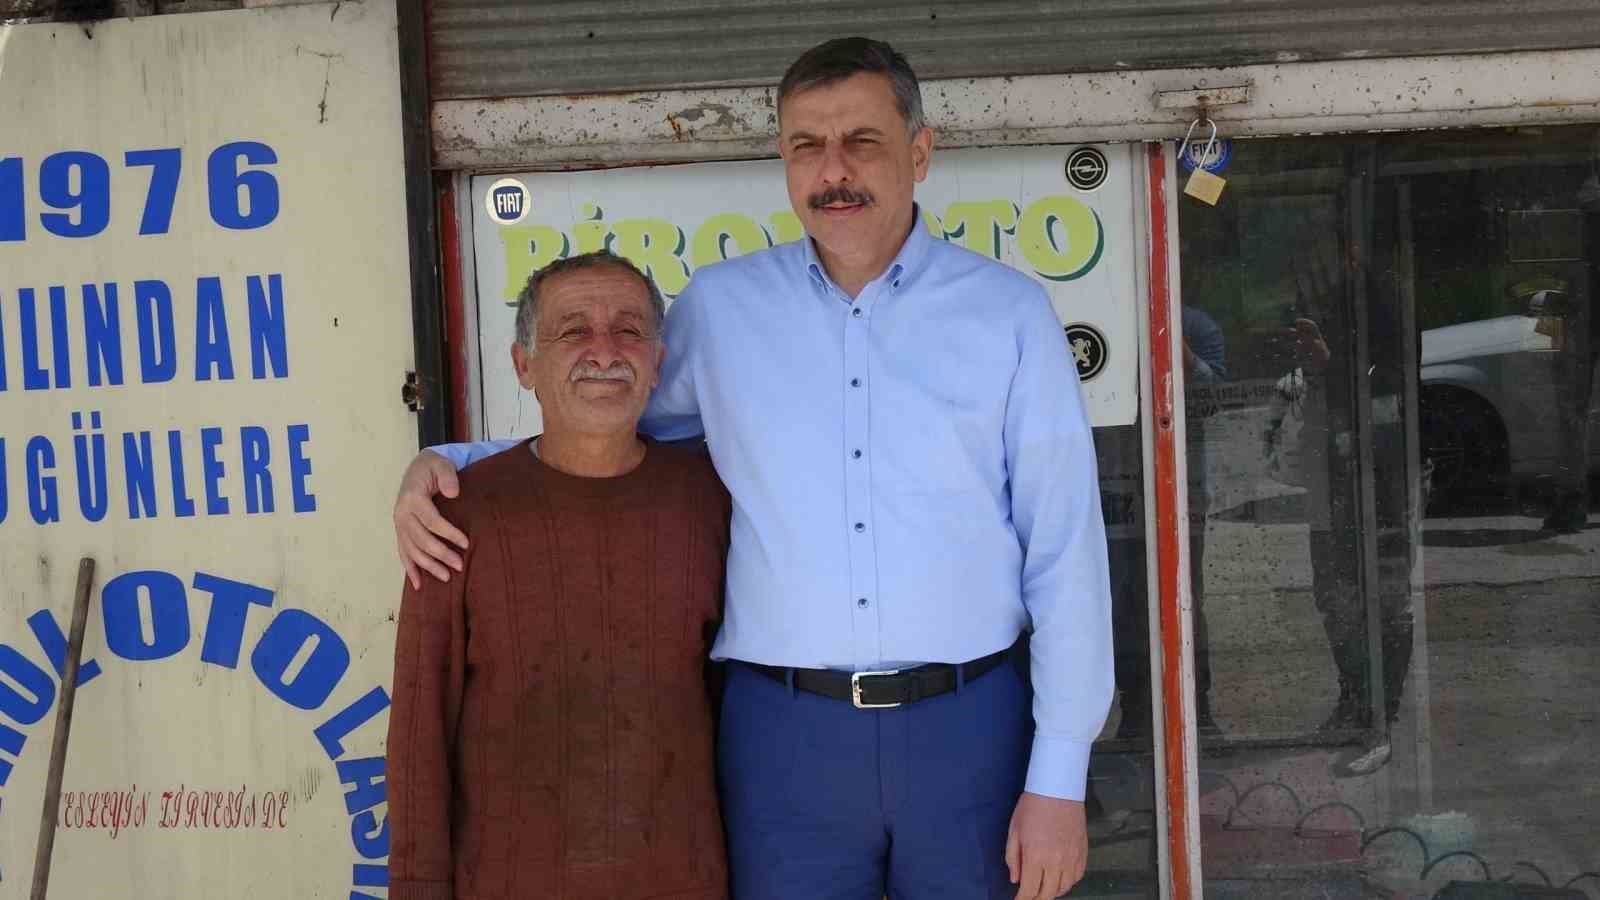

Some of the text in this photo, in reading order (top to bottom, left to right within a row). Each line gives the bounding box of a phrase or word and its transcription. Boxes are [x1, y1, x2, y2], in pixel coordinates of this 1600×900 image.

[0, 141, 280, 241] 1976
[496, 192, 521, 214] FIAT
[921, 194, 1104, 281] TO
